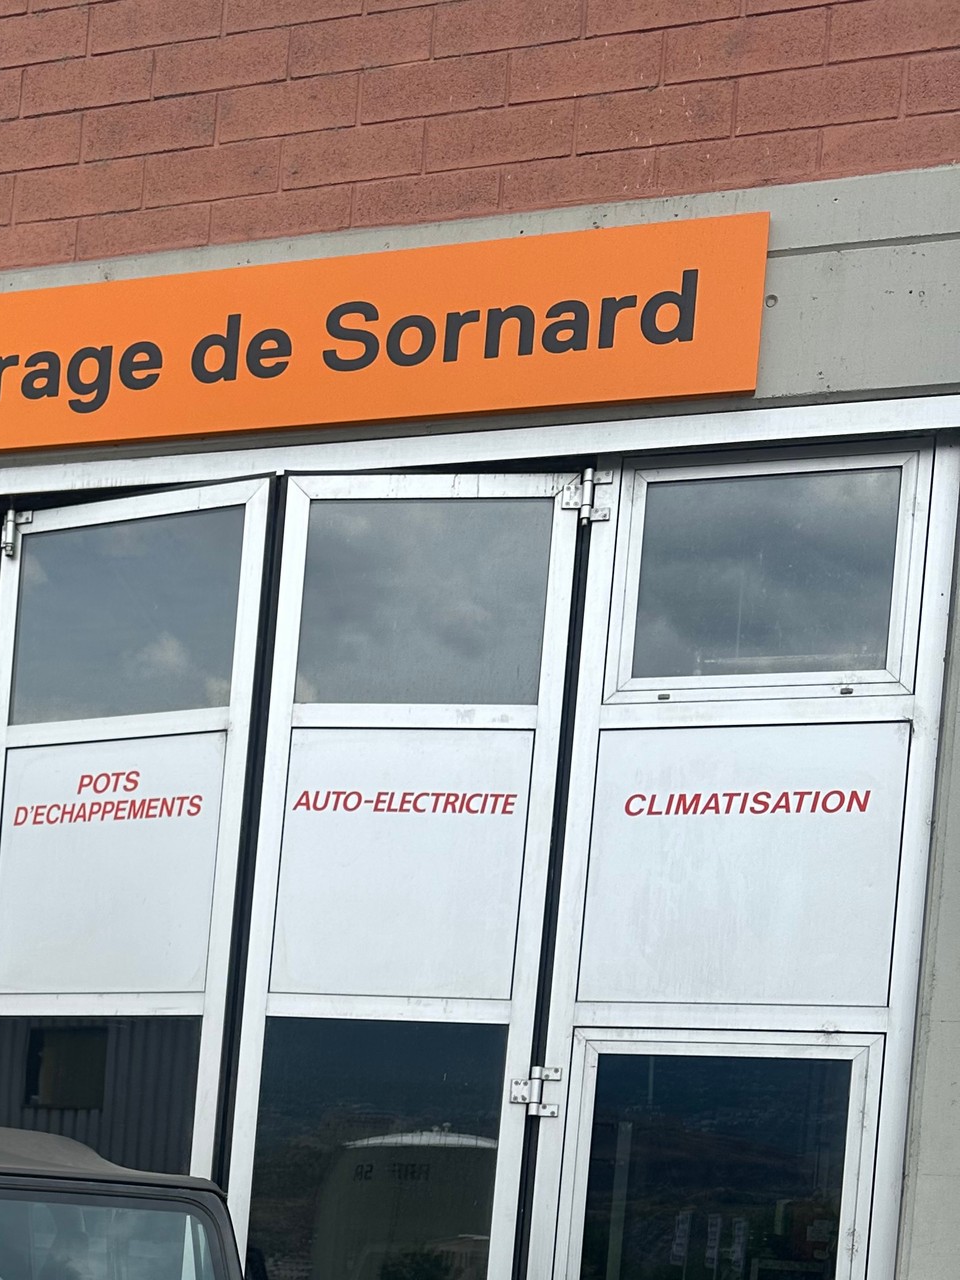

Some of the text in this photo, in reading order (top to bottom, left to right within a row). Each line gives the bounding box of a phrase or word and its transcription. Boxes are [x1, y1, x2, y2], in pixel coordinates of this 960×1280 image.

[190, 313, 292, 384] de
[322, 268, 699, 372] Sornard
[77, 770, 140, 795] POTS
[13, 794, 203, 827] D'ECHAPPEMENTS
[292, 789, 517, 817] AUTO-ELECTRICITE
[624, 789, 872, 818] CLIMATISATION
